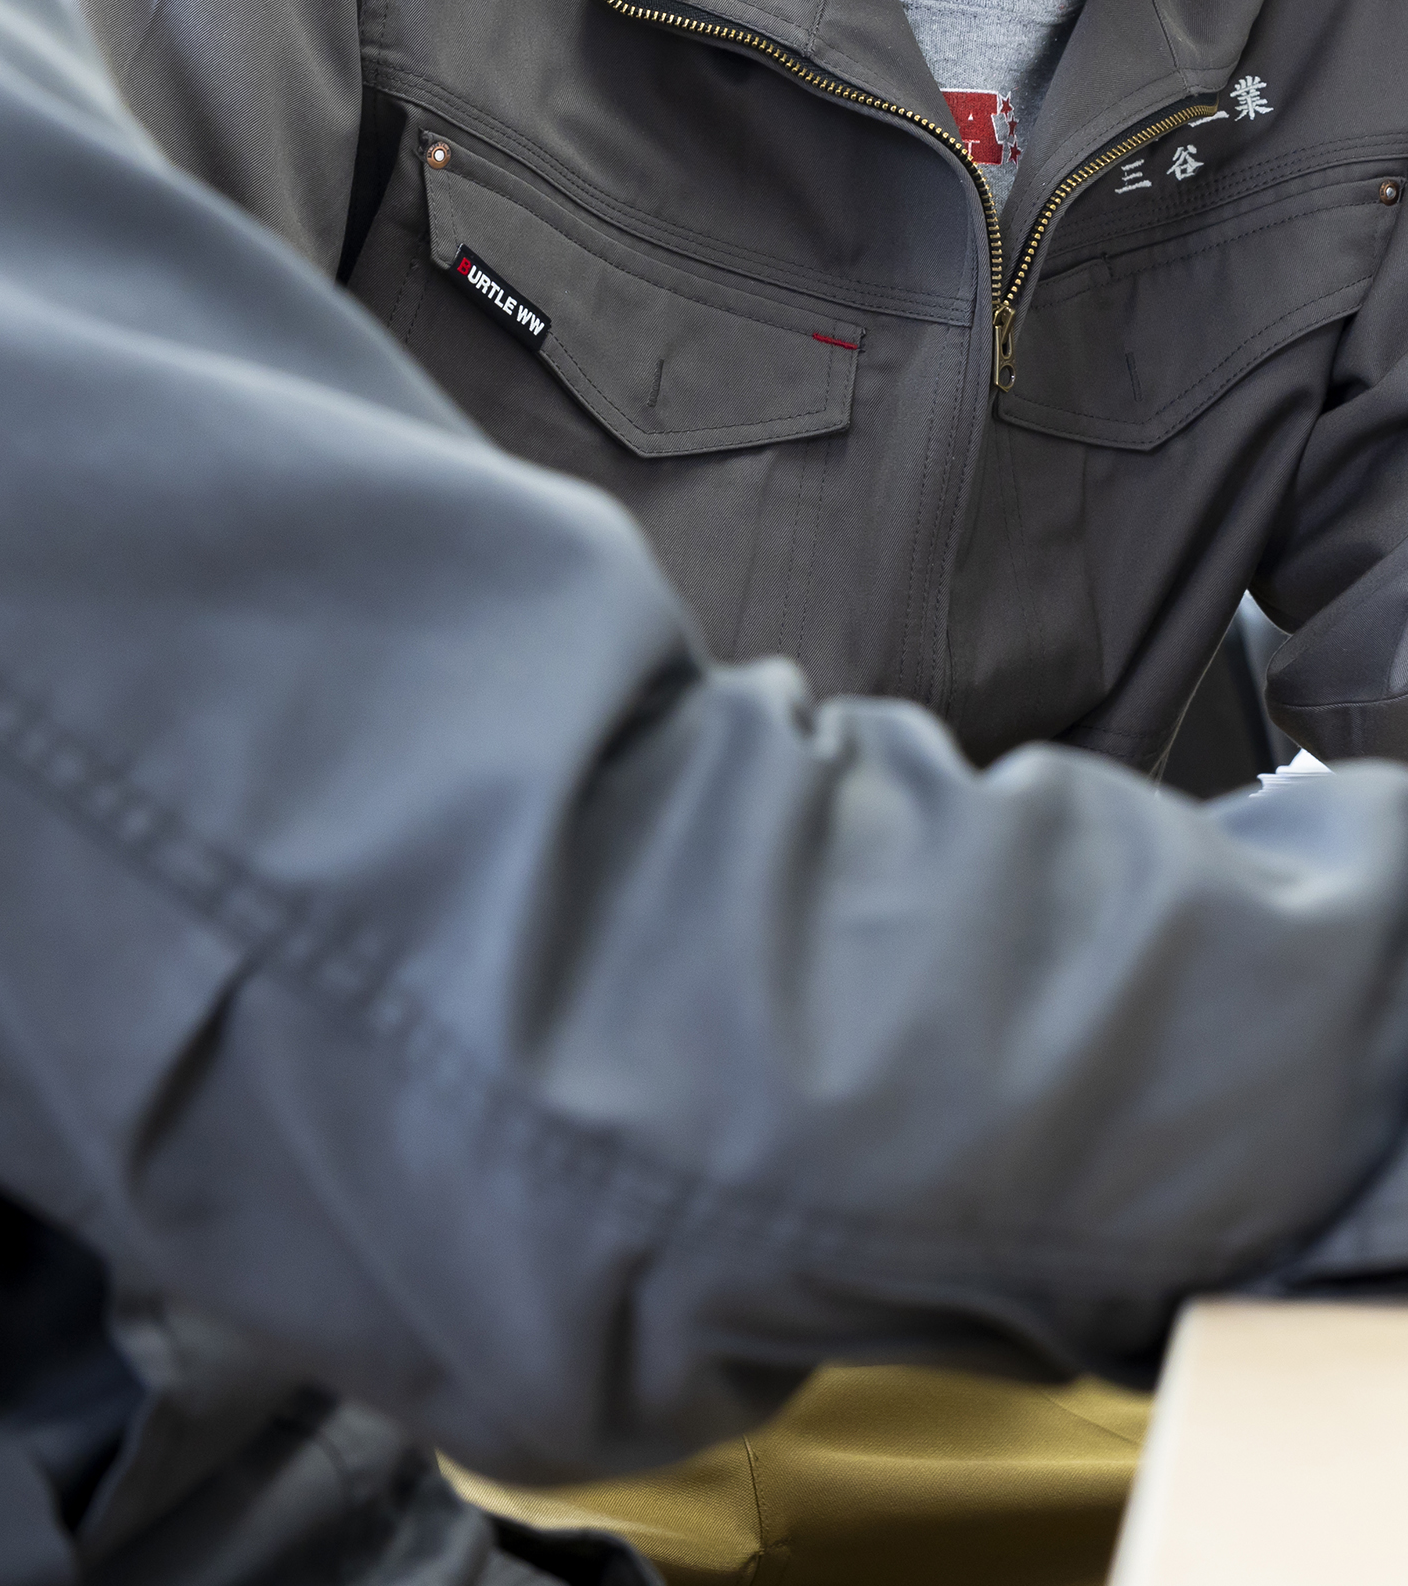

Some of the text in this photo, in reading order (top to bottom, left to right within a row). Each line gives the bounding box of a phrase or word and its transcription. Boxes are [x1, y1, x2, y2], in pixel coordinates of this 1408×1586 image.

[1188, 75, 1274, 127] 業
[1115, 145, 1204, 194] 三谷
[457, 257, 545, 336] BURTLE WW
